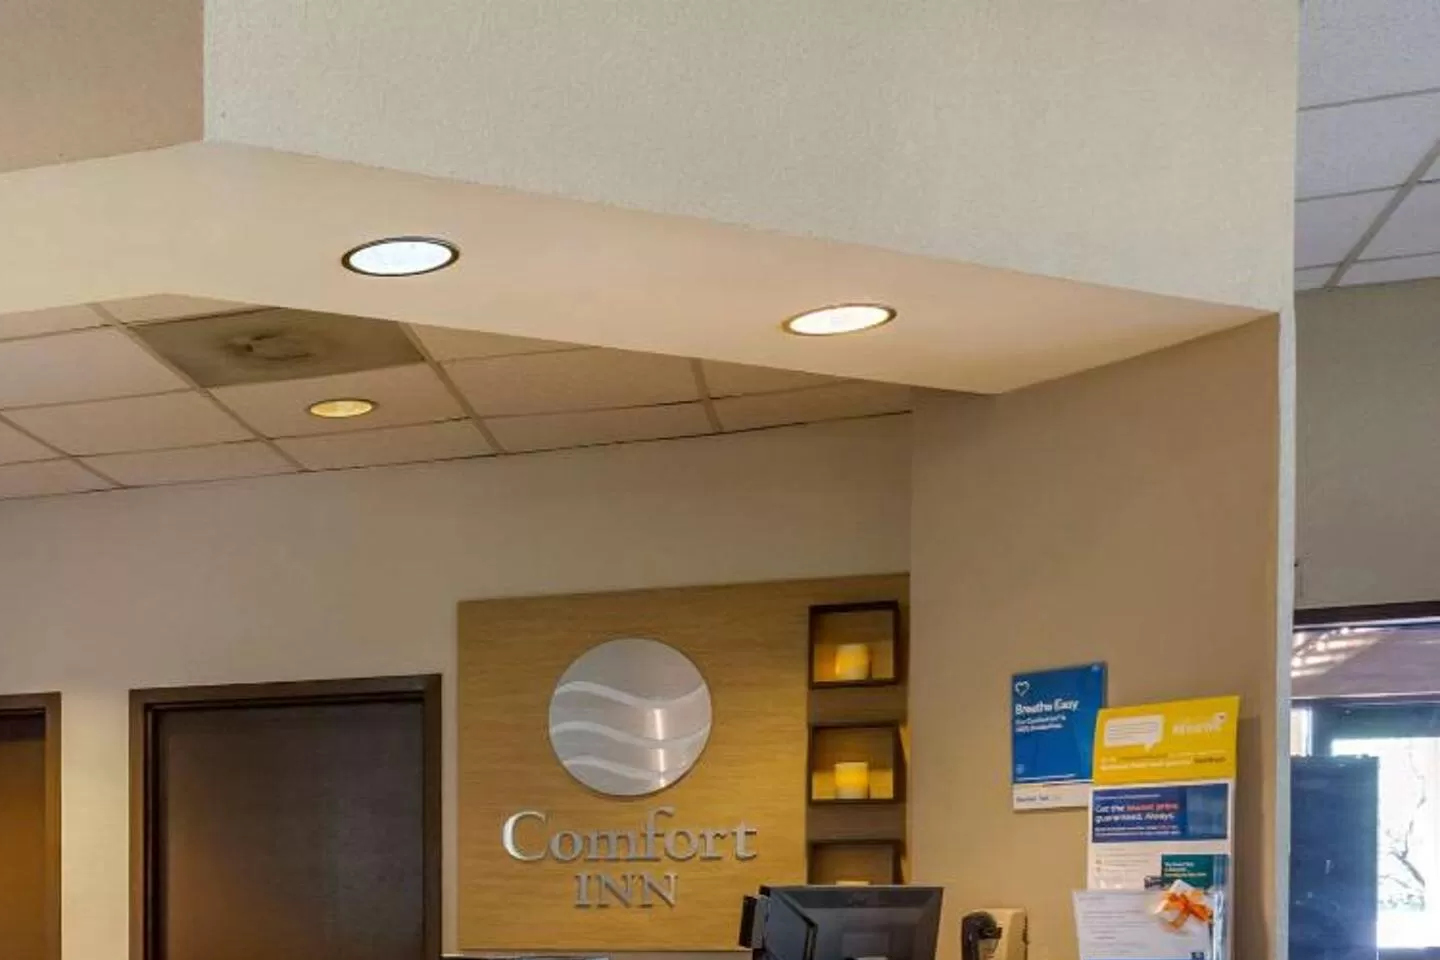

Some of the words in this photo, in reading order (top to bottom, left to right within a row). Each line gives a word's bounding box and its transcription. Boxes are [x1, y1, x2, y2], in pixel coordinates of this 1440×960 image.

[1014, 701, 1053, 715] Breathe
[1053, 698, 1080, 712] Easy
[502, 806, 758, 861] Comfort
[574, 871, 678, 909] INN
